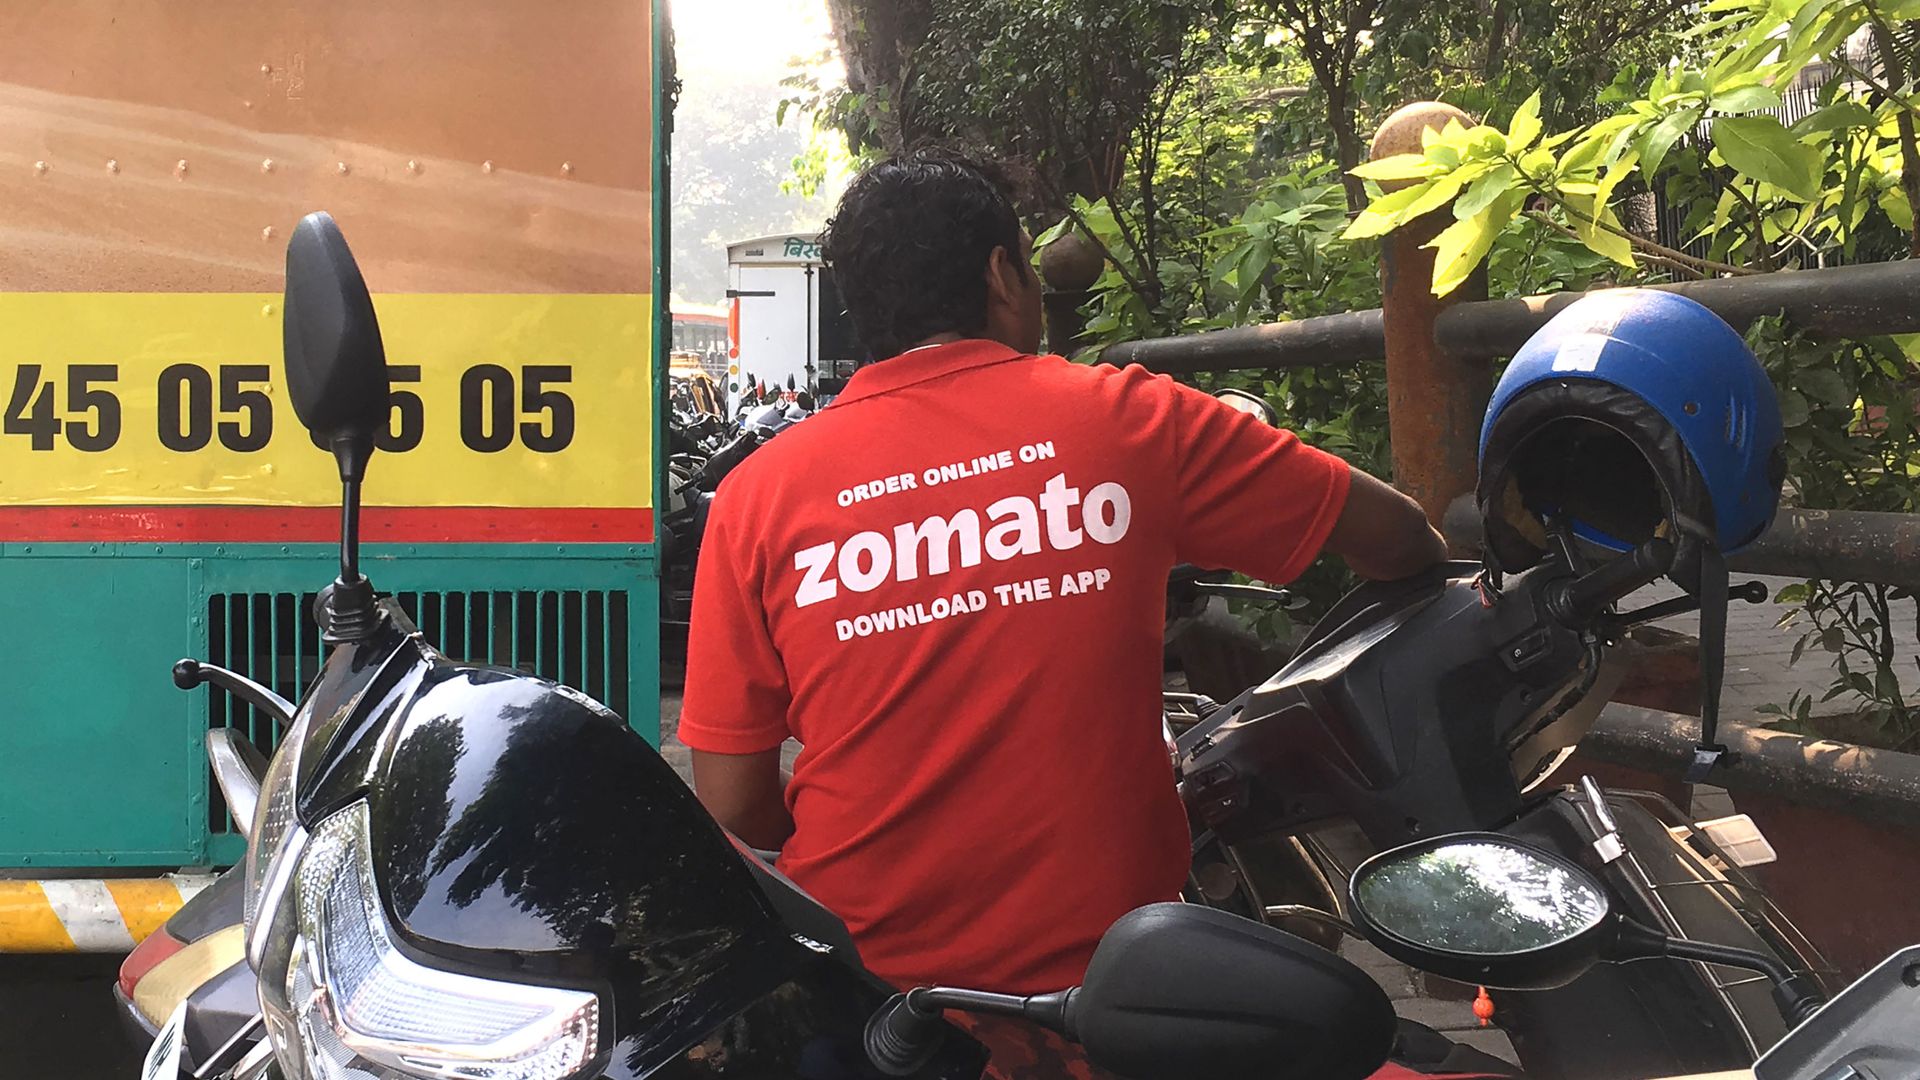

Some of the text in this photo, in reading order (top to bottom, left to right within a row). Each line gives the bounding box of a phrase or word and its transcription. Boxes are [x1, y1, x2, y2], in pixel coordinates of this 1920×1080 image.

[3, 364, 122, 453] 45
[157, 363, 273, 453] 05
[459, 363, 575, 454] 05
[836, 440, 1056, 508] ORDER ONLINE ON
[794, 471, 1132, 609] zomato
[835, 567, 1112, 642] DOWNLOAD THE APP
